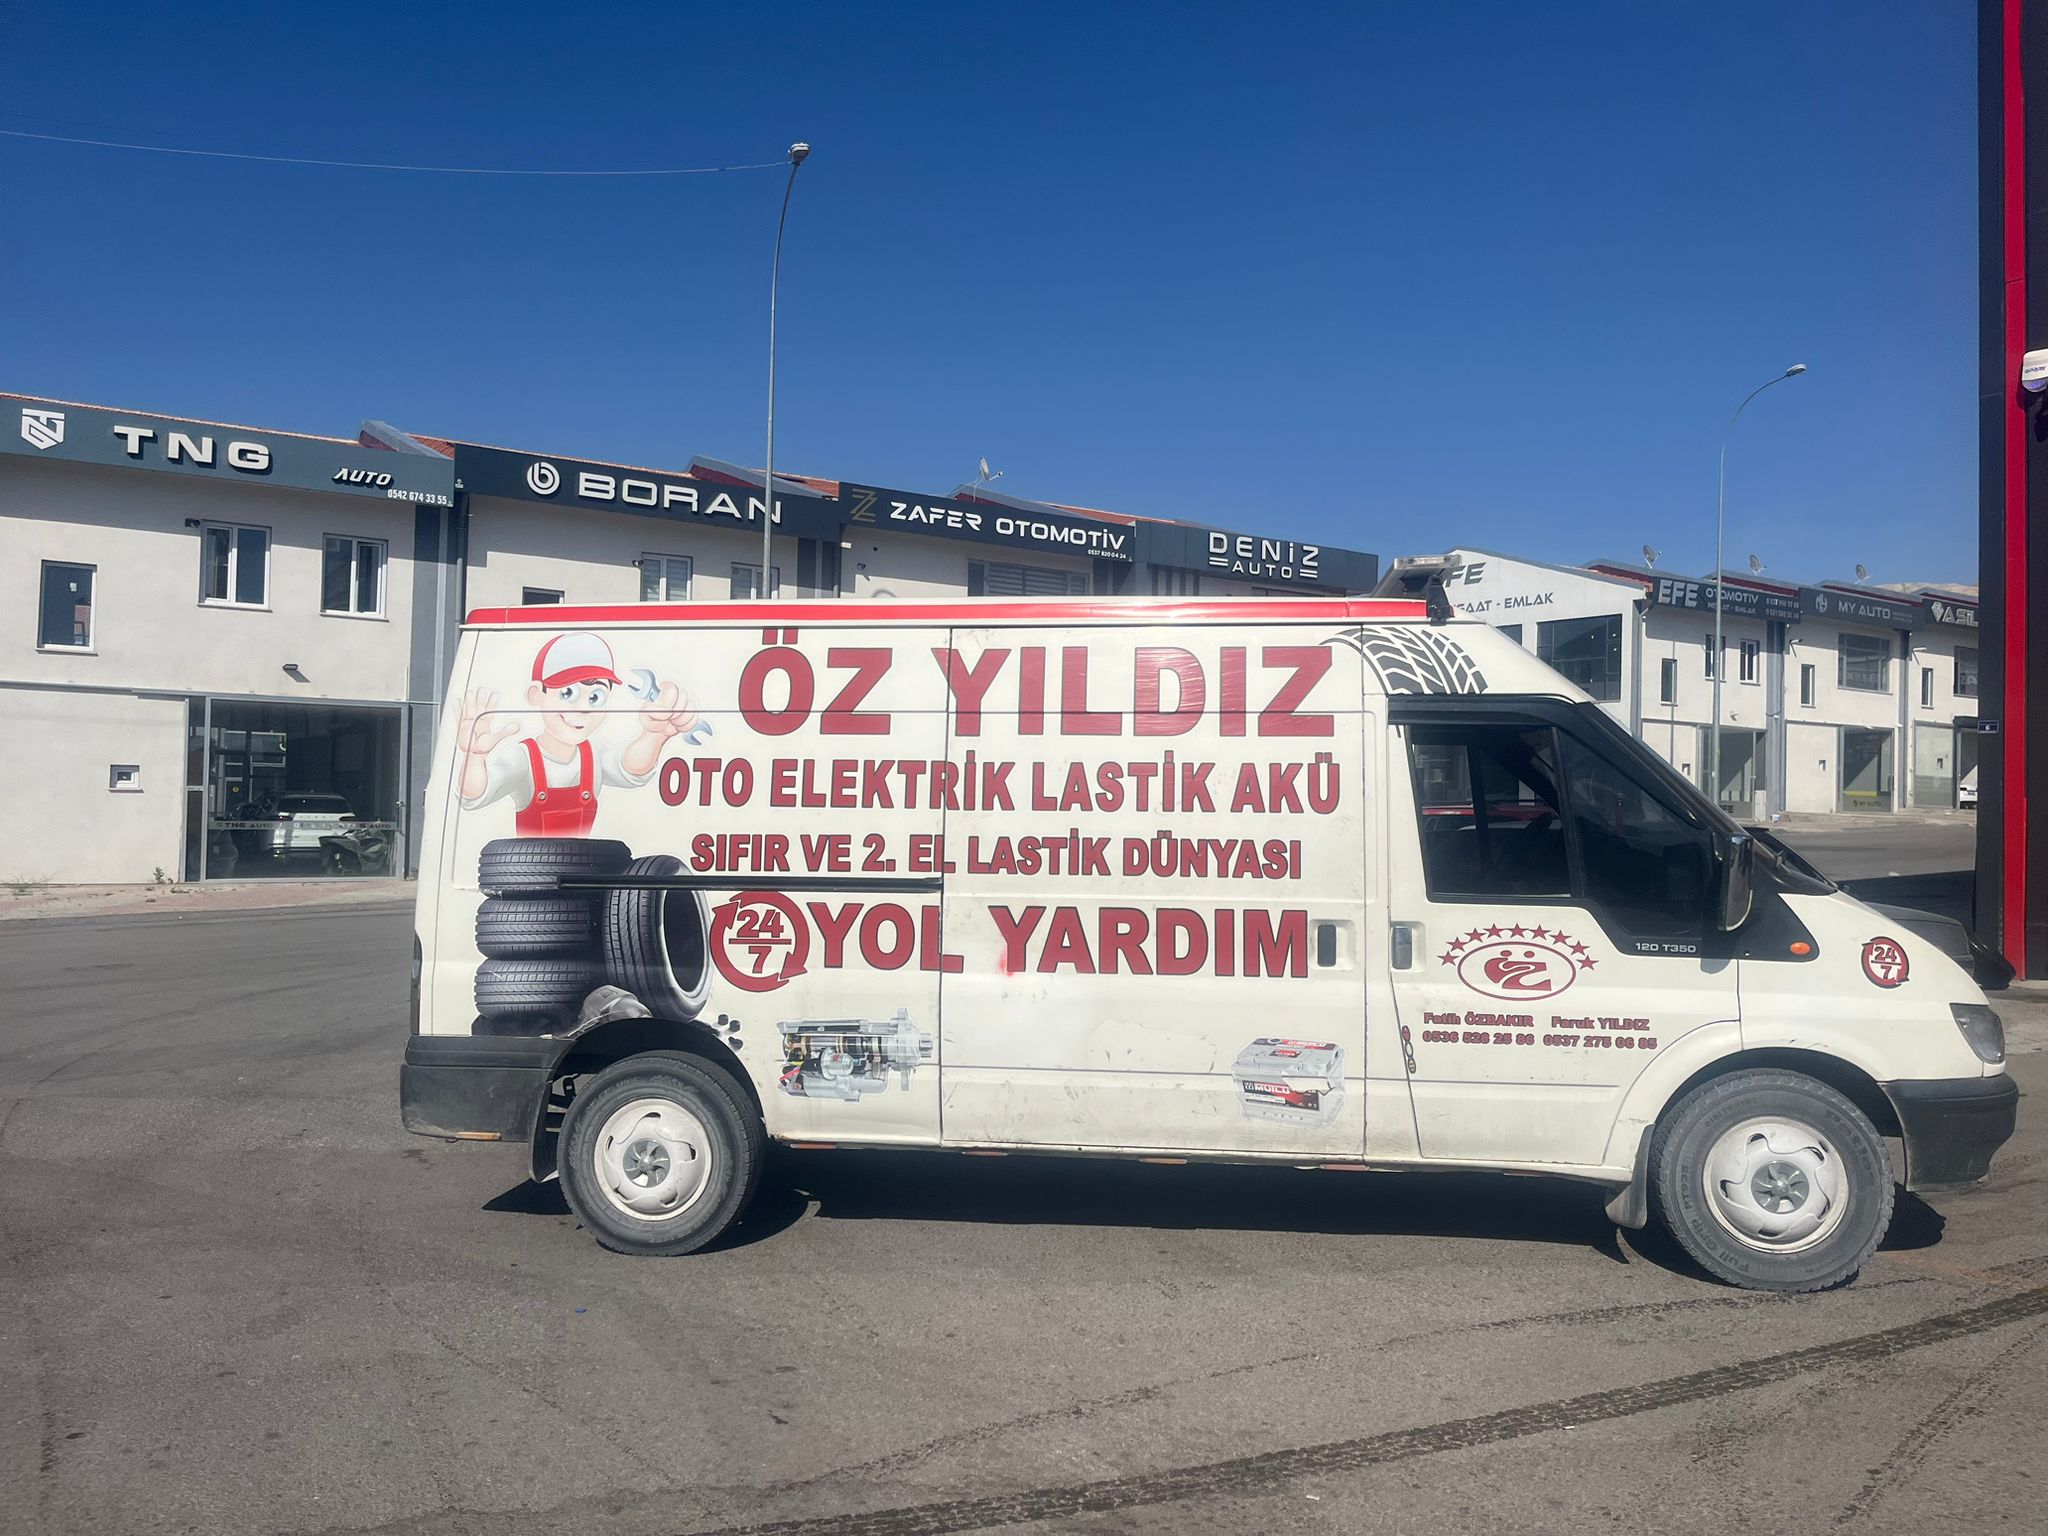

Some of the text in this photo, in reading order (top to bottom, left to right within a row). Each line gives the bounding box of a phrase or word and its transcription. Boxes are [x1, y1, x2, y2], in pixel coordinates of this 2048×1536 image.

[114, 425, 270, 469] TNG
[333, 467, 392, 486] AUTO
[387, 489, 448, 505] 0542 674 33 55
[578, 471, 781, 524] BORAN
[890, 501, 1125, 550] ZAFER OTOMOTİV
[1232, 560, 1293, 579] AUTO
[1443, 562, 1486, 587] FE
[1504, 592, 1554, 609] EMLAK
[1658, 579, 1699, 607] EFE
[1705, 587, 1759, 604] OOMOTIV
[1838, 600, 1856, 614] MY
[1858, 604, 1891, 619] AUTO
[738, 627, 1335, 738] ÖZ YILDIZ
[659, 750, 1341, 816] OTO ELEKTRİK LASTİK AKÜ
[691, 828, 1302, 880] SIFIR VE 2. EL LASTİK DÜNYASI
[736, 909, 784, 938] 24
[807, 902, 1308, 978] YOL YARDIM
[1635, 942, 1697, 953] 120 T350
[748, 945, 772, 974] 7
[1874, 946, 1897, 962] 24
[1880, 964, 1892, 980] 7
[1424, 1012, 1461, 1025] Fatih
[1551, 1016, 1650, 1031] Faruk YILDIZ
[1543, 1034, 1580, 1047] 0537
